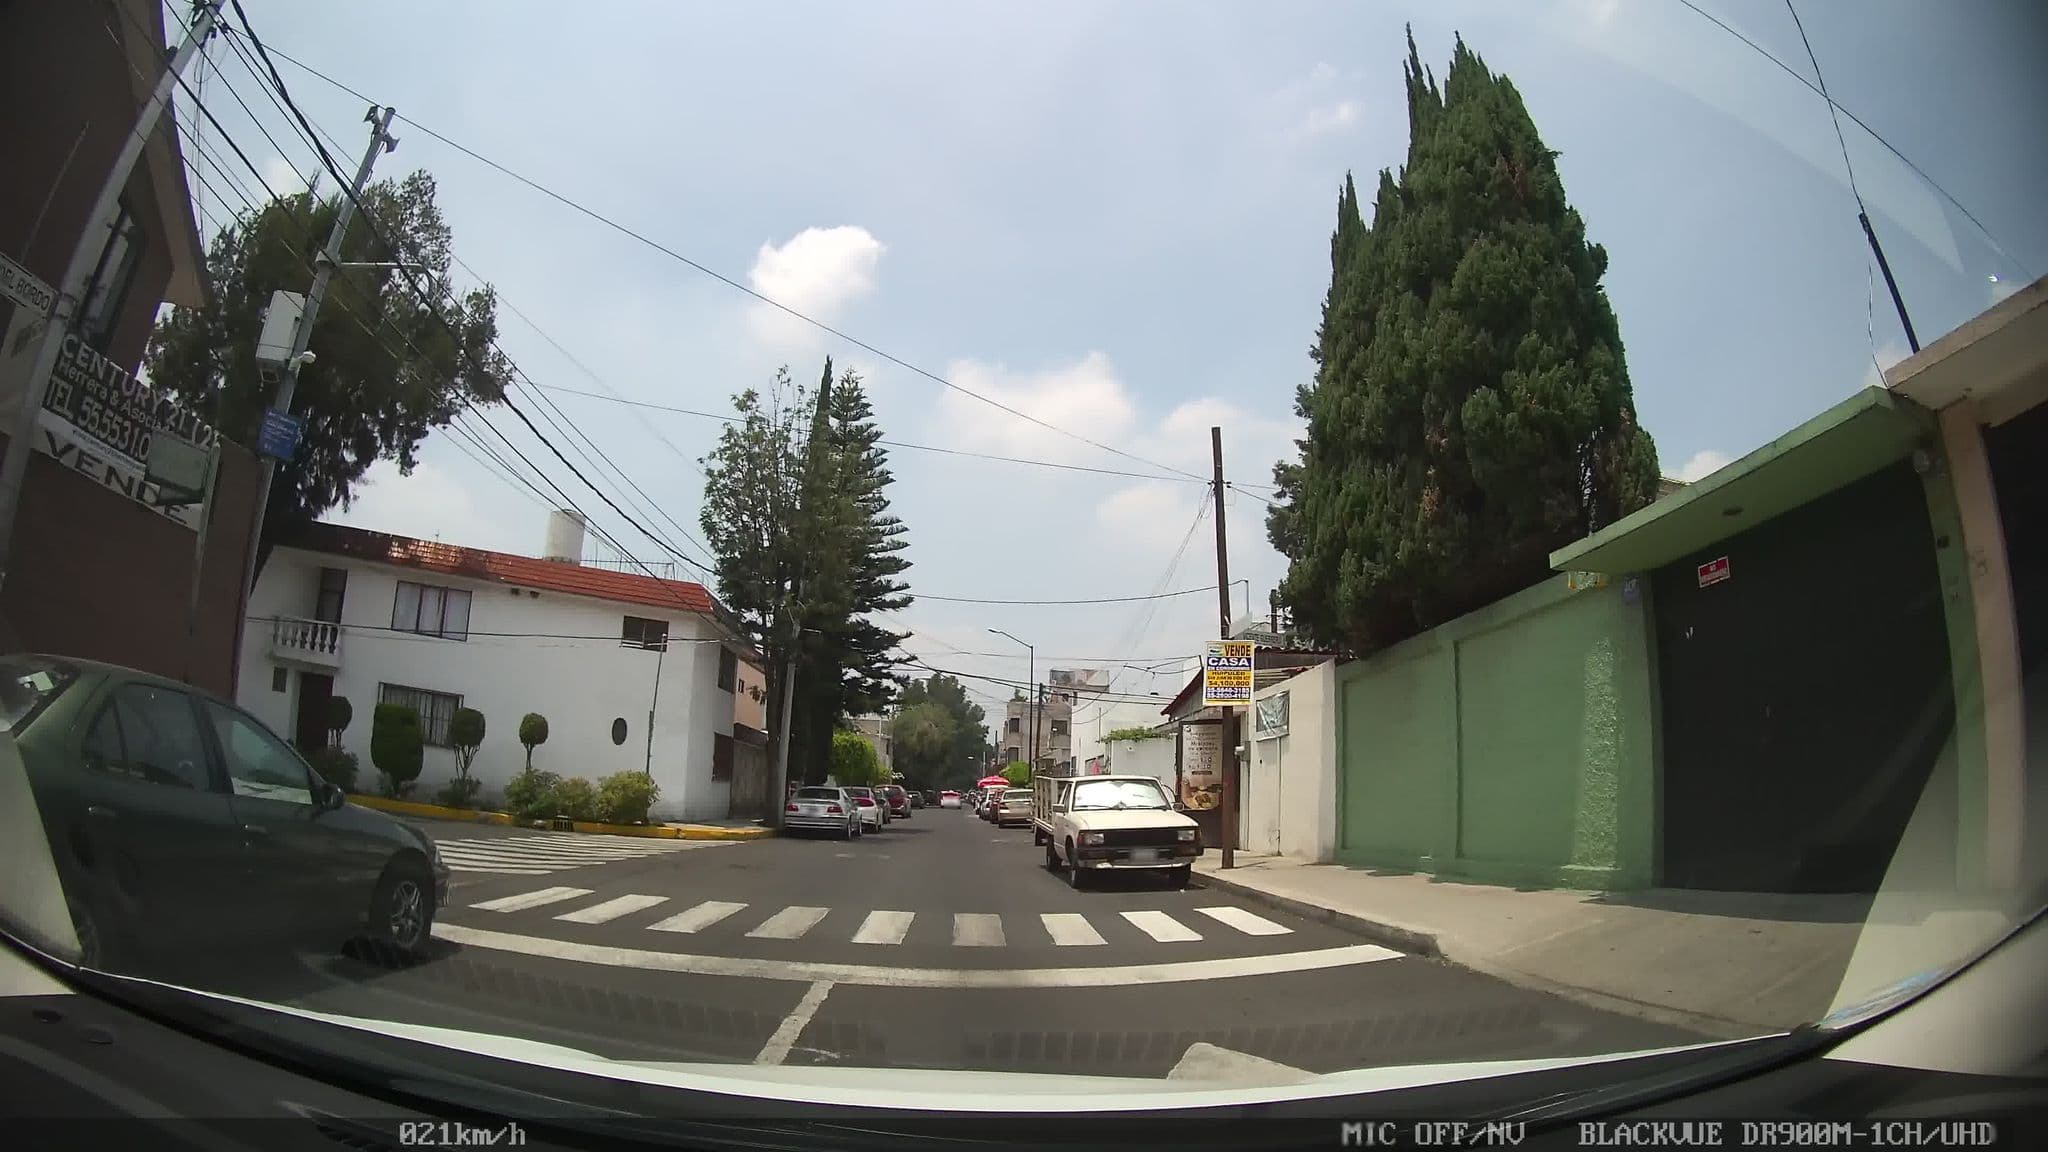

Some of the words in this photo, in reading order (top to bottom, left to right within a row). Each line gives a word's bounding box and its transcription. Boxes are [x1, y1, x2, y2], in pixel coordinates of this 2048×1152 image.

[15, 277, 50, 311] BORDO
[58, 359, 107, 399] Herrera
[110, 391, 119, 406] &
[62, 333, 165, 414] CENTURY
[77, 396, 151, 461] 55.5531.0
[1208, 657, 1250, 666] CASA
[1225, 645, 1251, 657] VENDE
